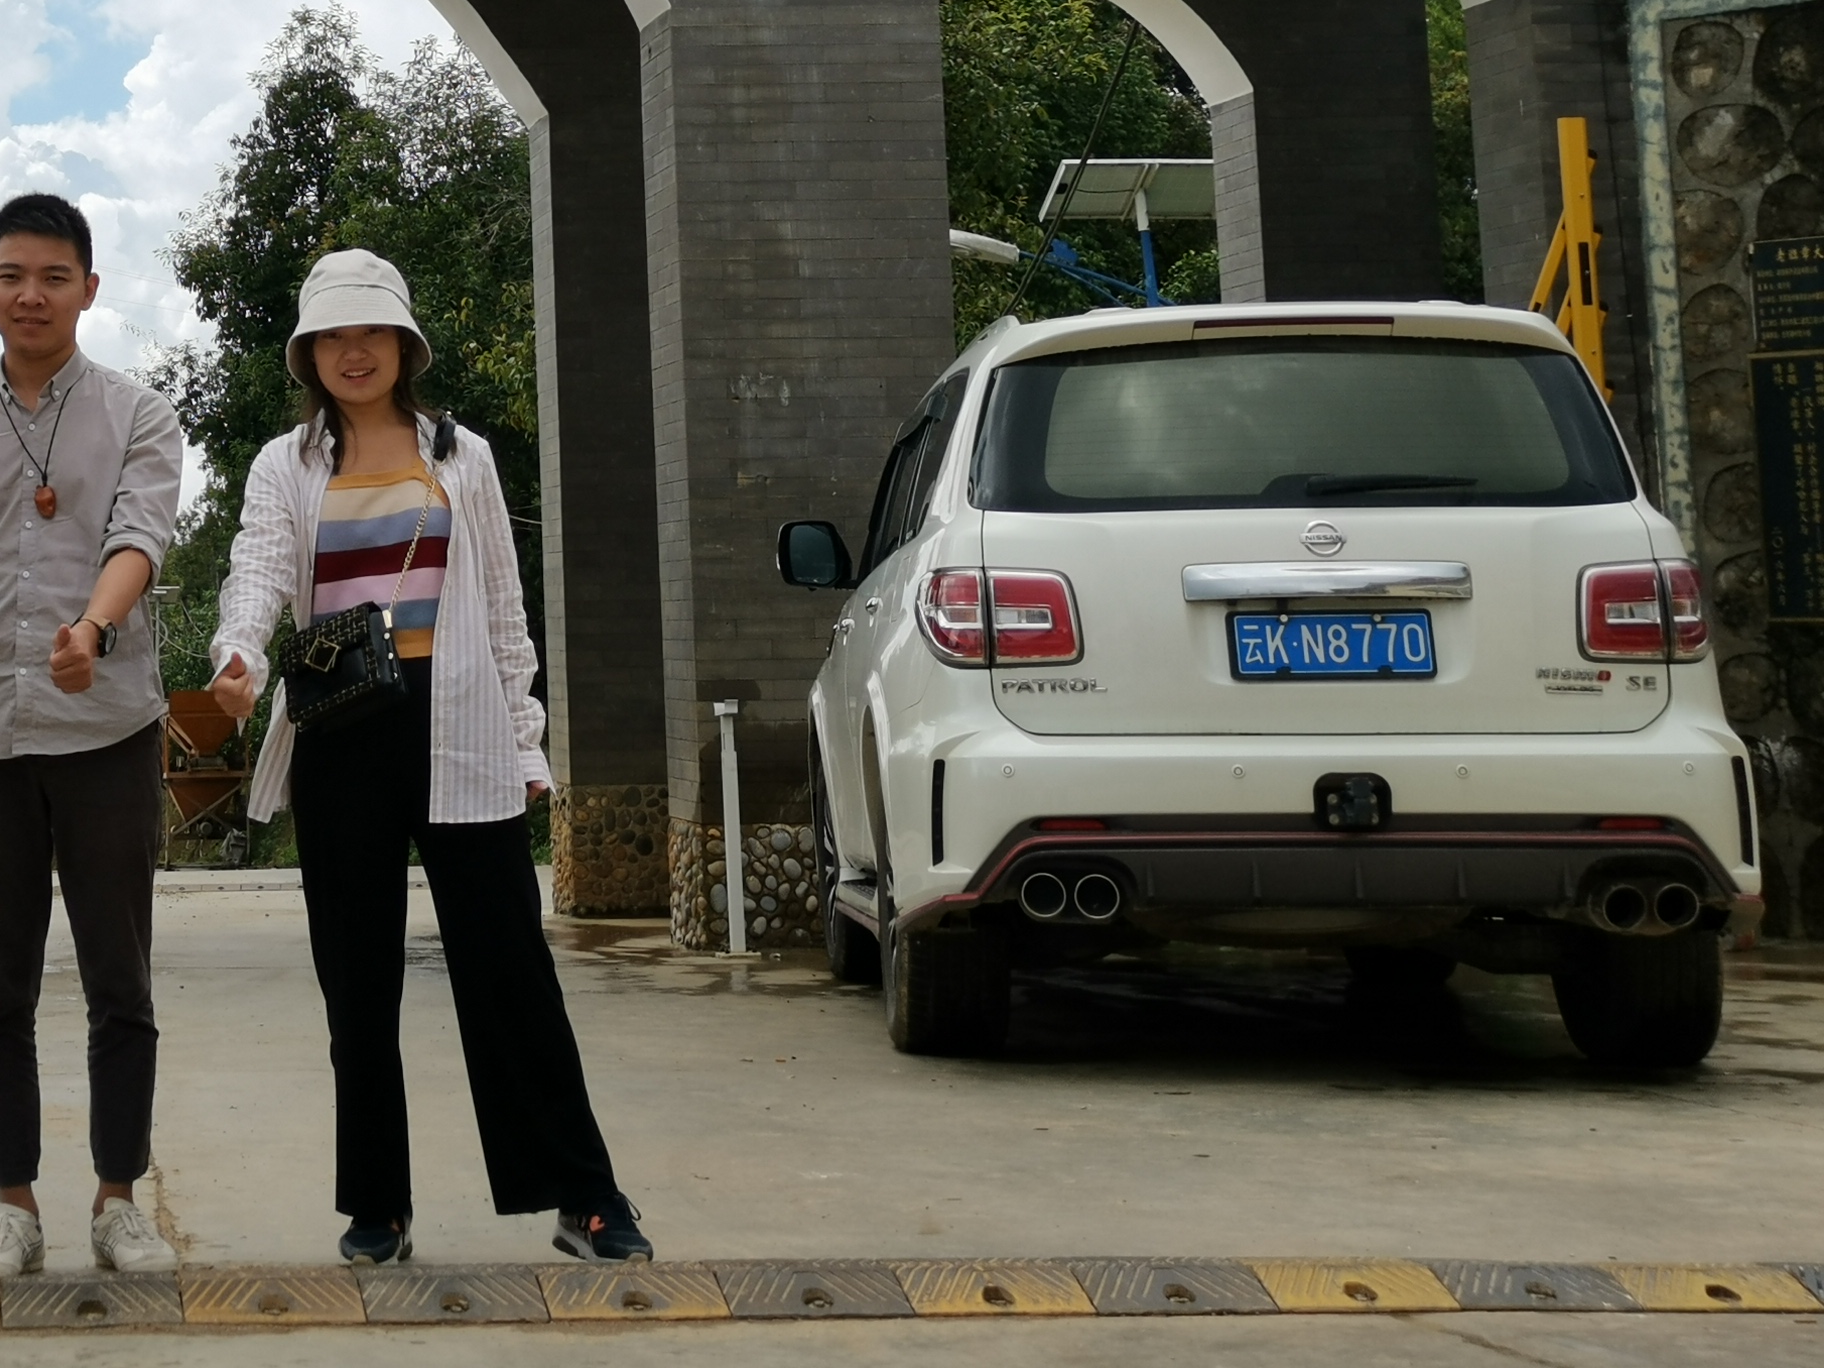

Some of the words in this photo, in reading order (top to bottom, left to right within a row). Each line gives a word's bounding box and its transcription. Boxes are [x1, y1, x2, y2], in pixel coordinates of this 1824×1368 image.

[1304, 534, 1343, 542] NISSAN
[1001, 677, 1108, 694] PATROL
[1626, 675, 1658, 691] SE
